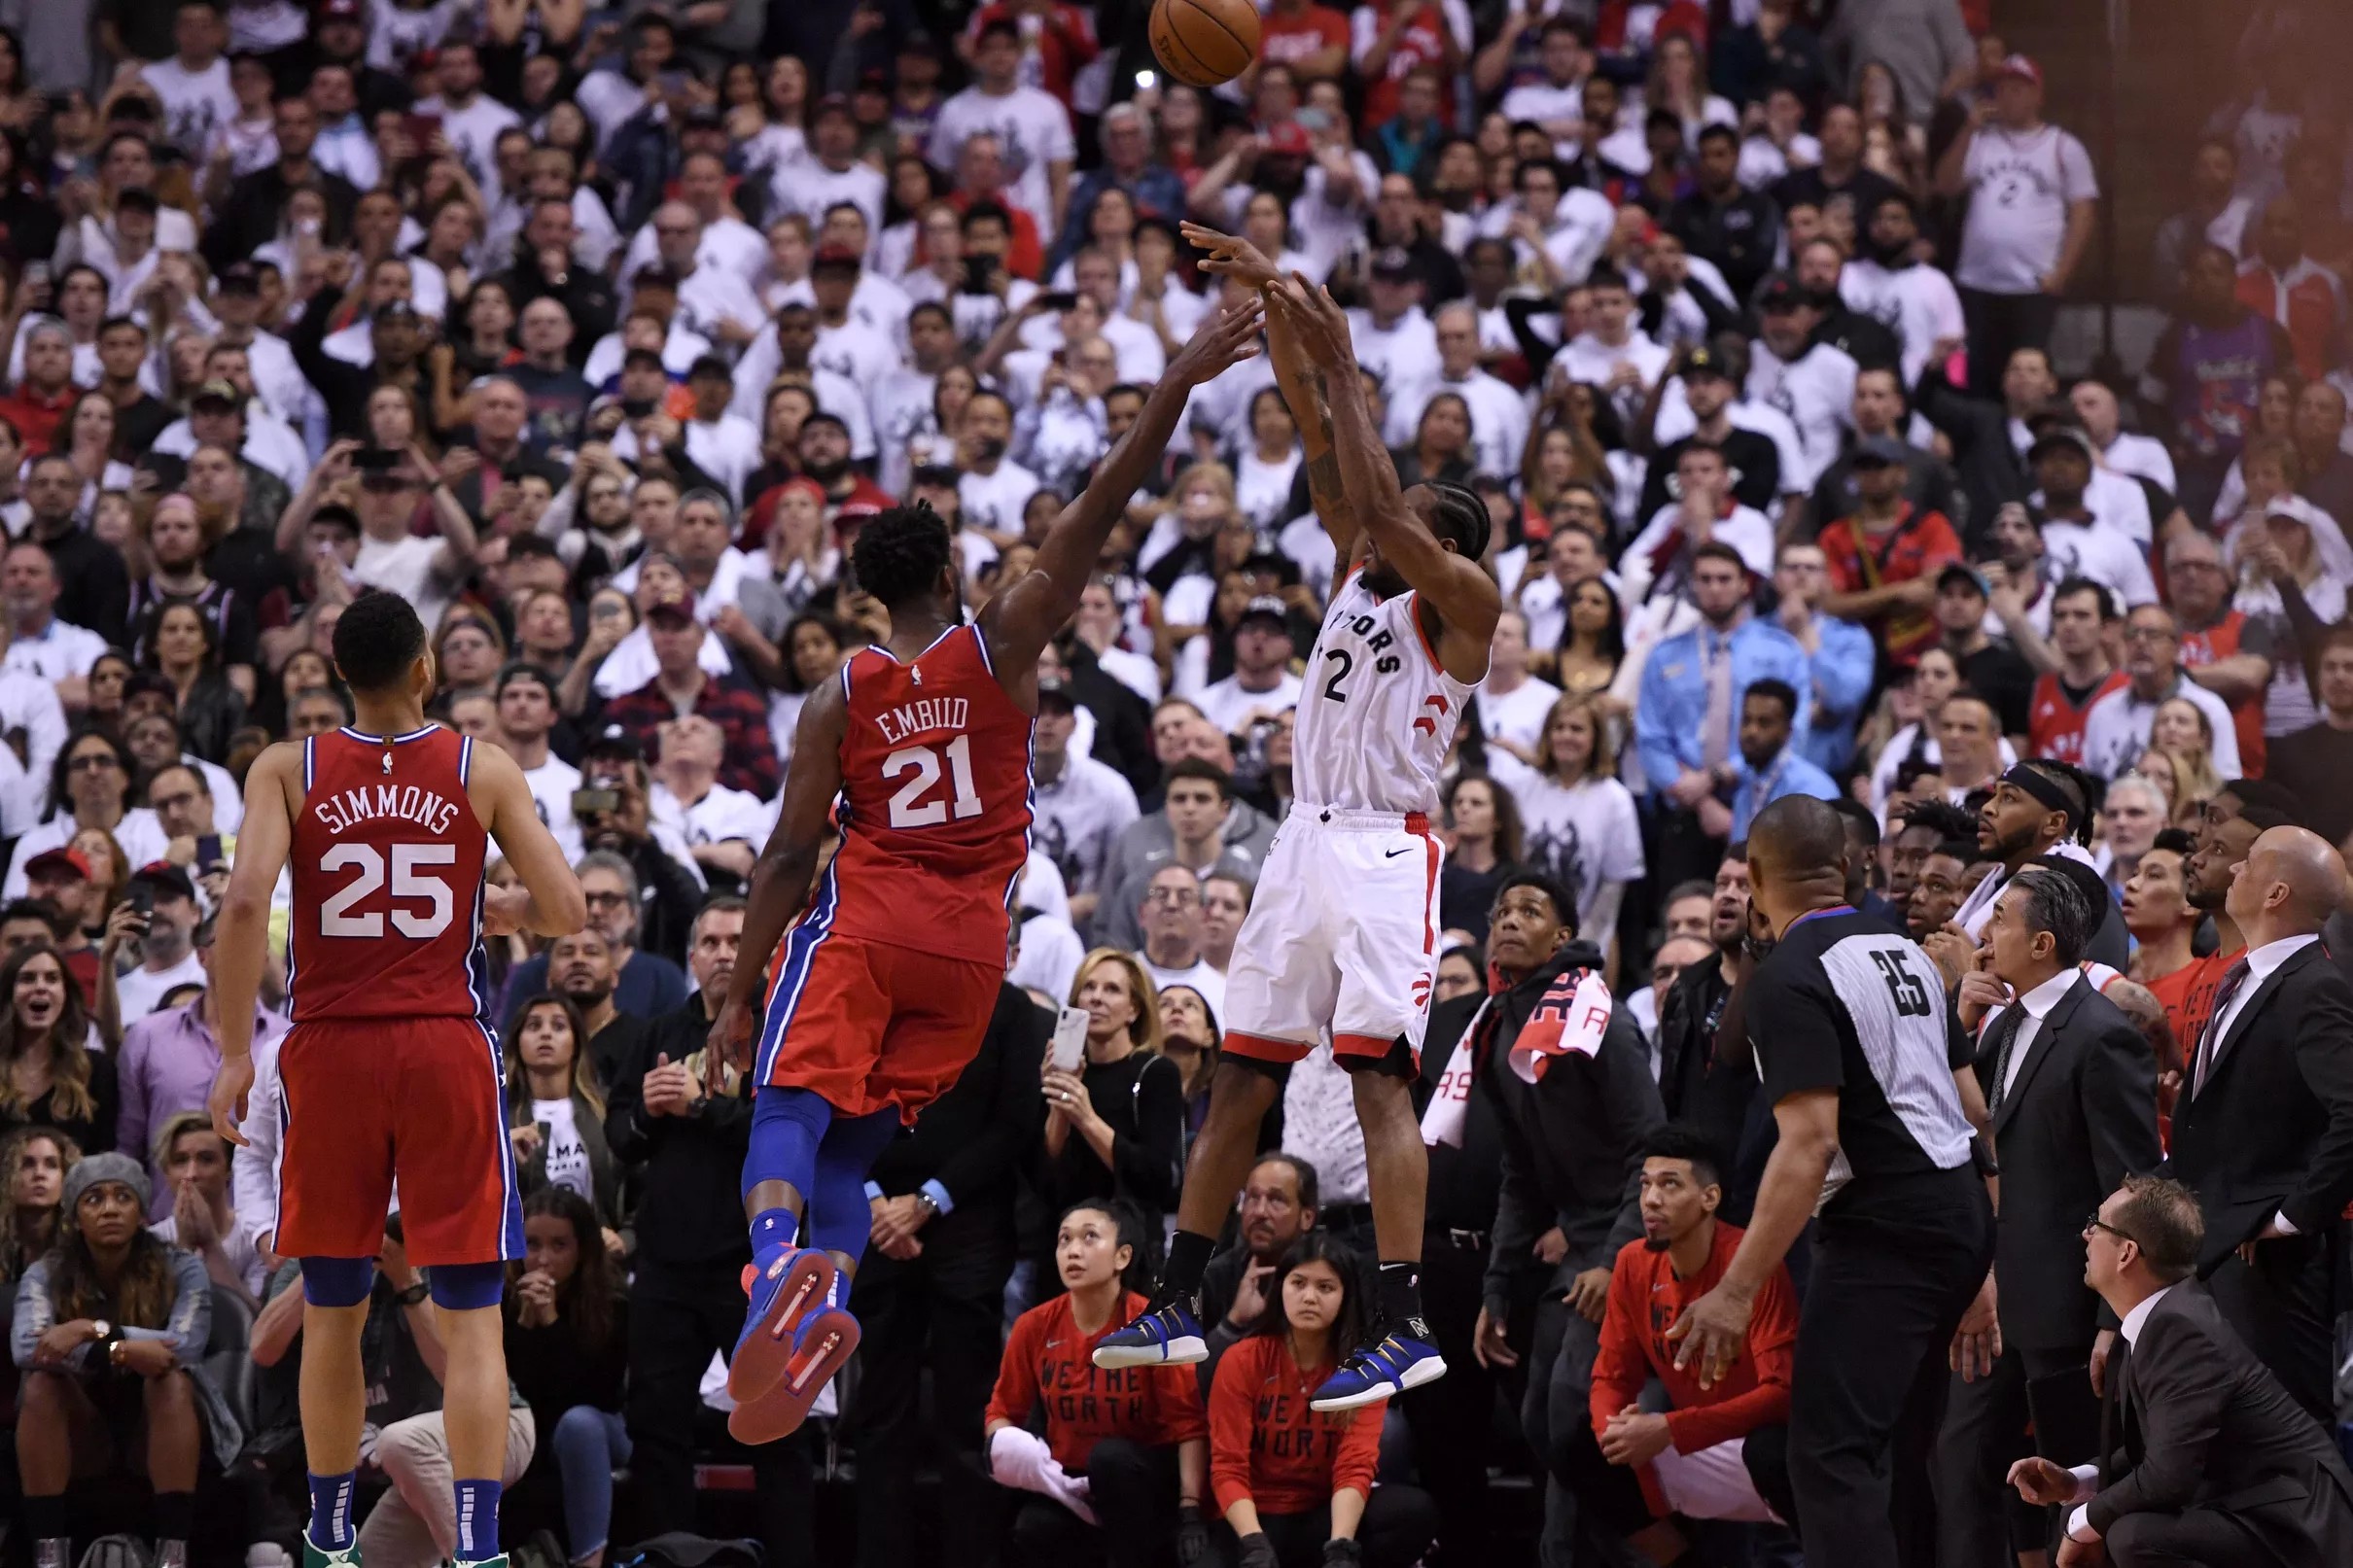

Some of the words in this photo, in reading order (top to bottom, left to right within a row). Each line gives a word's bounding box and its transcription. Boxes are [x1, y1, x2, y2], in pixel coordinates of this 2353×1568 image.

[1323, 648, 1352, 703] 2
[875, 697, 968, 745] EMBIID
[881, 734, 983, 828] 21
[315, 784, 459, 835] SIMMONS
[320, 843, 456, 938] 25
[1869, 950, 1931, 1017] 25
[1041, 1357, 1073, 1390] WE
[1258, 1395, 1289, 1422] WE
[1250, 1425, 1341, 1458] NORT
